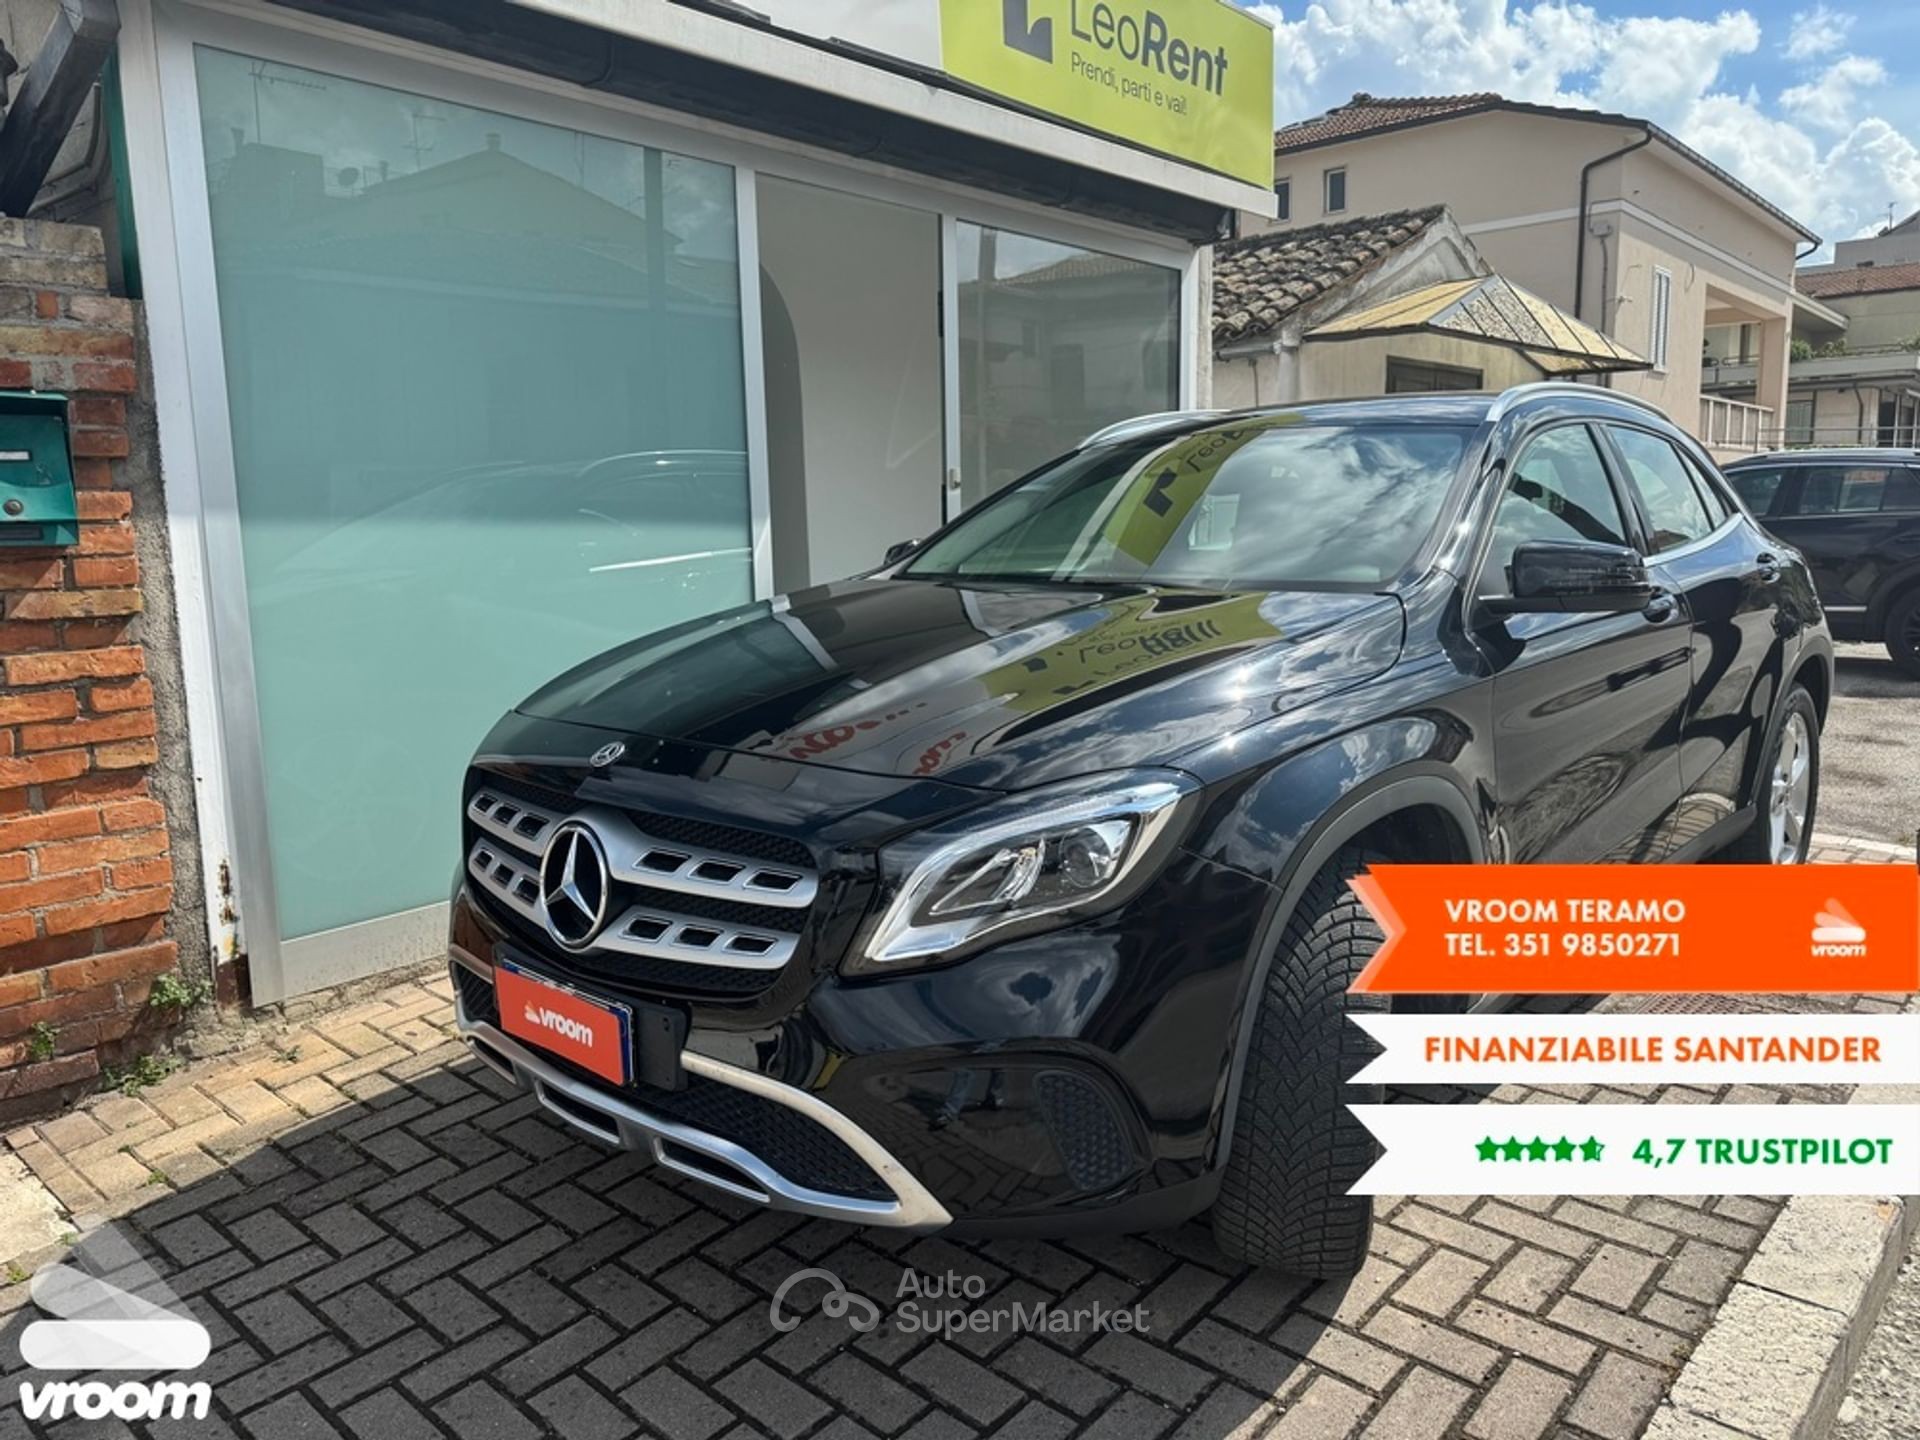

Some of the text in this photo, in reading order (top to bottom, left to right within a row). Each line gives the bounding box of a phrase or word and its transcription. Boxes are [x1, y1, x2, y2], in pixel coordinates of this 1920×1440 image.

[1071, 0, 1228, 96] LeoRent
[1121, 78, 1152, 103] parti
[1153, 91, 1164, 107] e
